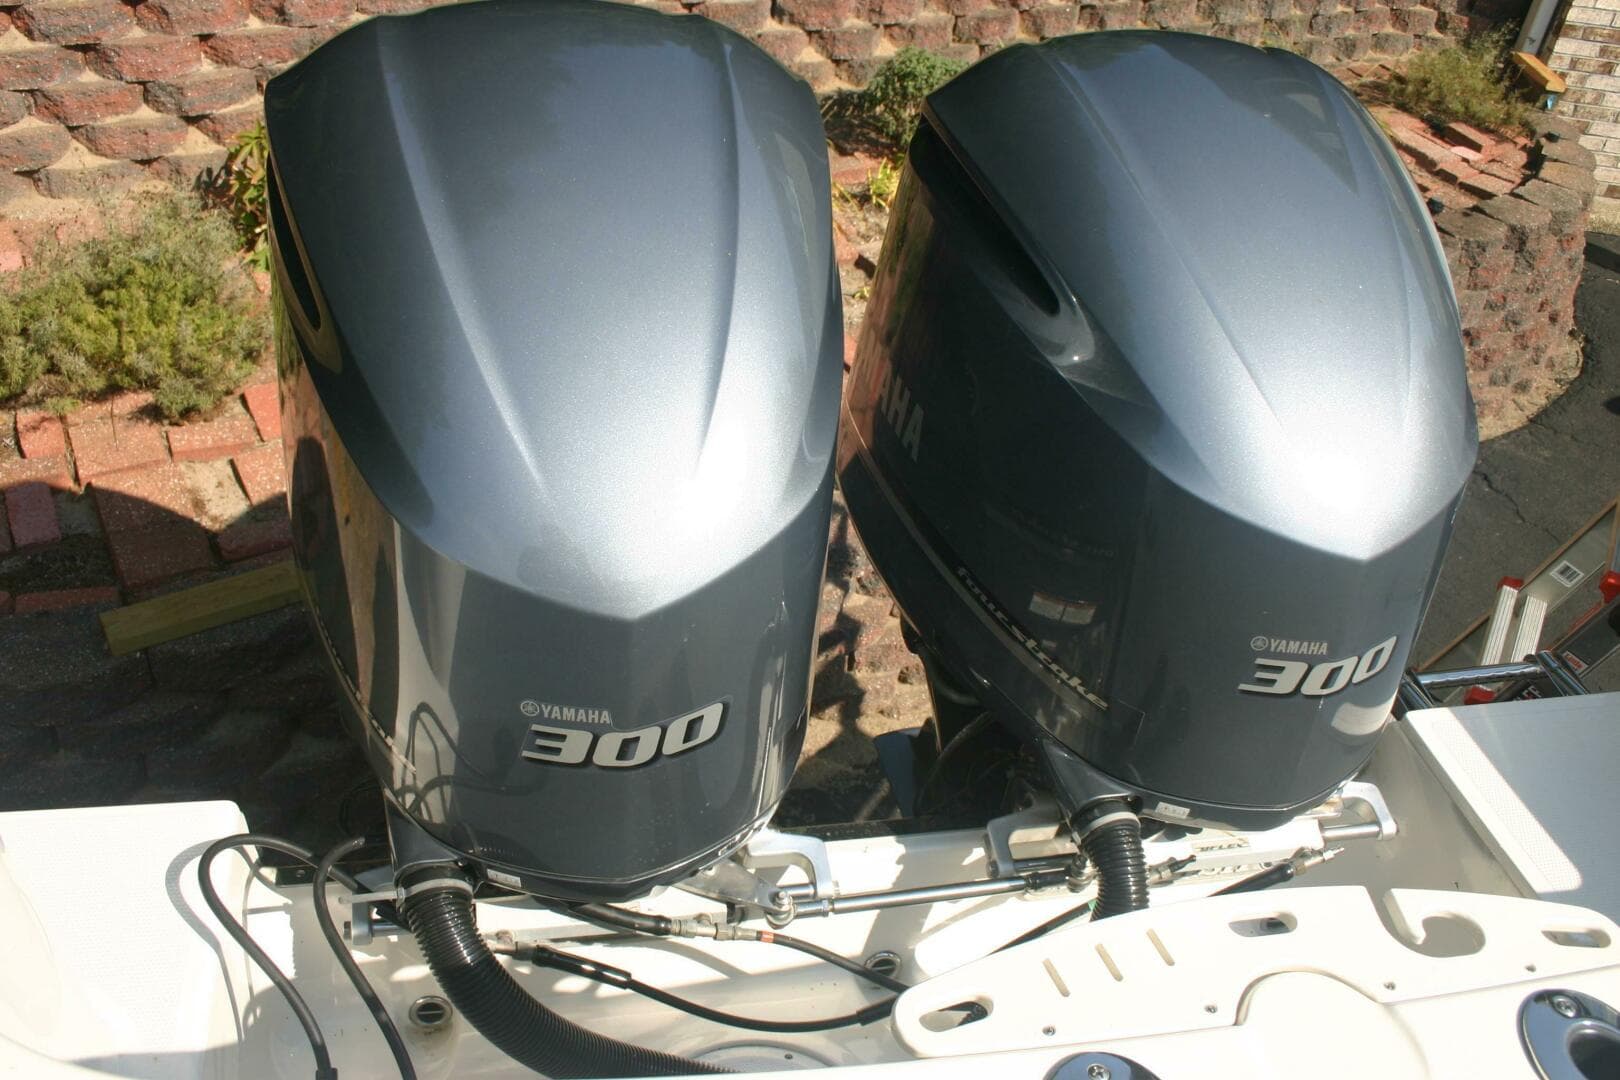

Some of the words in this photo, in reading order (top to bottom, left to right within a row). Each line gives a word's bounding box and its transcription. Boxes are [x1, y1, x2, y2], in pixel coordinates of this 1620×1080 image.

[1237, 635, 1397, 696] 300
[1271, 638, 1329, 656] YAMAHA
[521, 702, 724, 768] 300
[541, 704, 611, 725] YAMAHA
